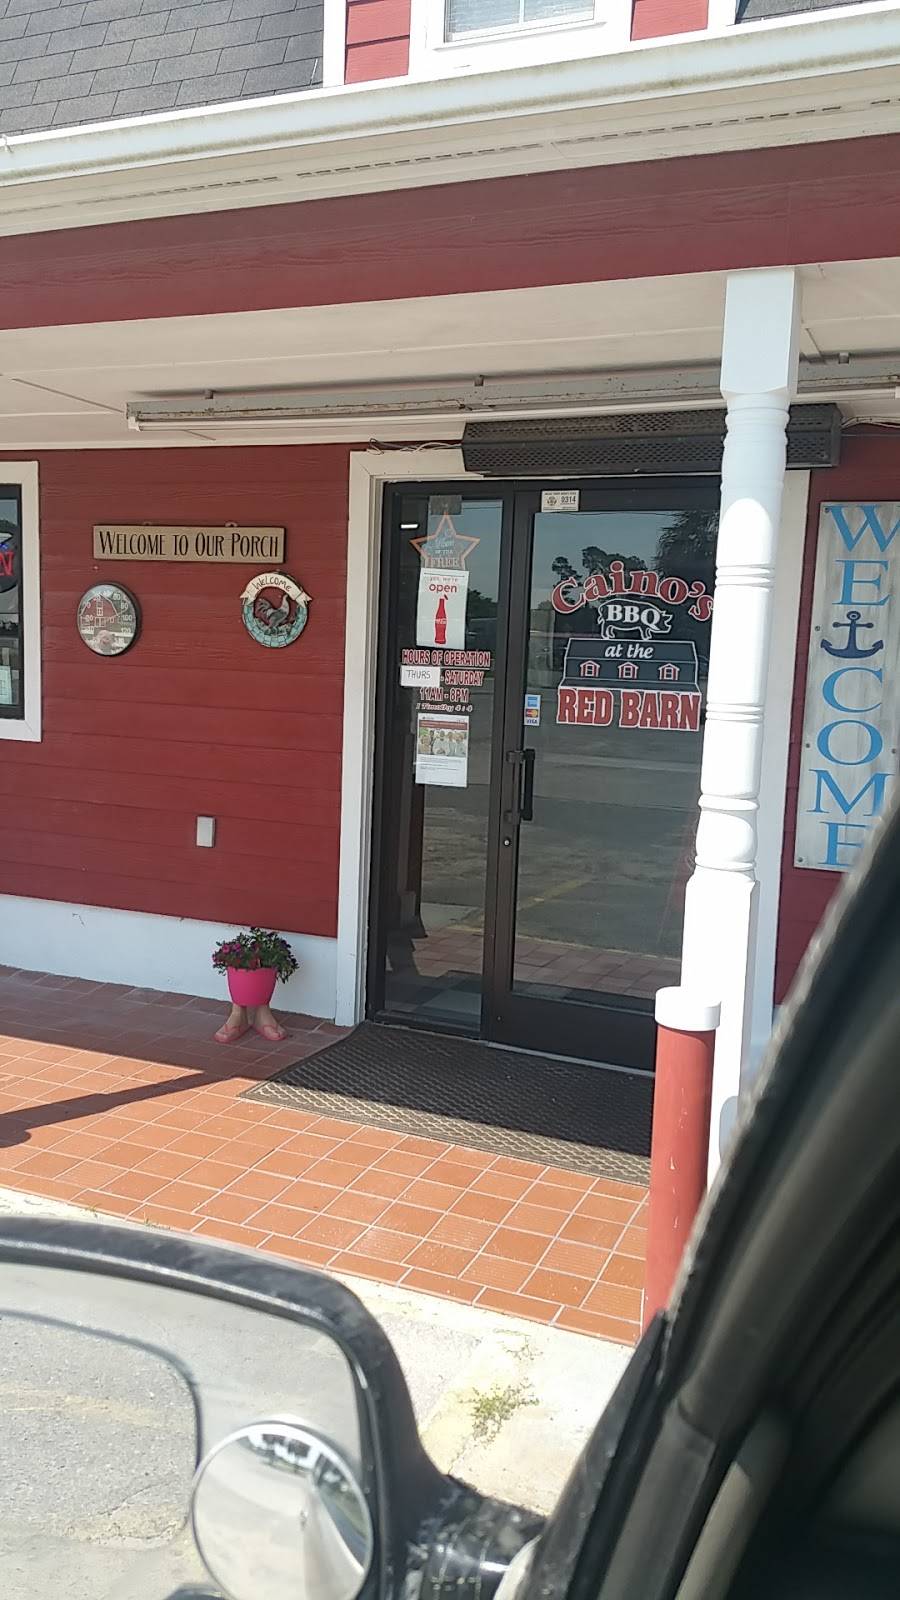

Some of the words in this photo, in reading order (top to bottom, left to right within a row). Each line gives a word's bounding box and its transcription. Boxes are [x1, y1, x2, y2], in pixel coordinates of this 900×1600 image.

[99, 531, 166, 556] WELCOME
[173, 534, 189, 556] TO
[195, 532, 225, 557] OUR
[231, 532, 279, 558] PORCH
[429, 583, 458, 594] open
[551, 560, 714, 622] Caino's
[606, 604, 661, 631] BBQ
[401, 649, 431, 665] HOURS
[431, 650, 443, 666] OF
[443, 650, 491, 668] OPERATION
[605, 644, 622, 658] at
[627, 643, 654, 659] the
[406, 669, 431, 680] THURS
[445, 669, 485, 687] SATURDAY
[419, 687, 444, 702] 11AM
[450, 688, 469, 703] 8PM
[421, 703, 454, 713] Timothy
[556, 686, 614, 727] RED
[619, 689, 703, 732] BARN
